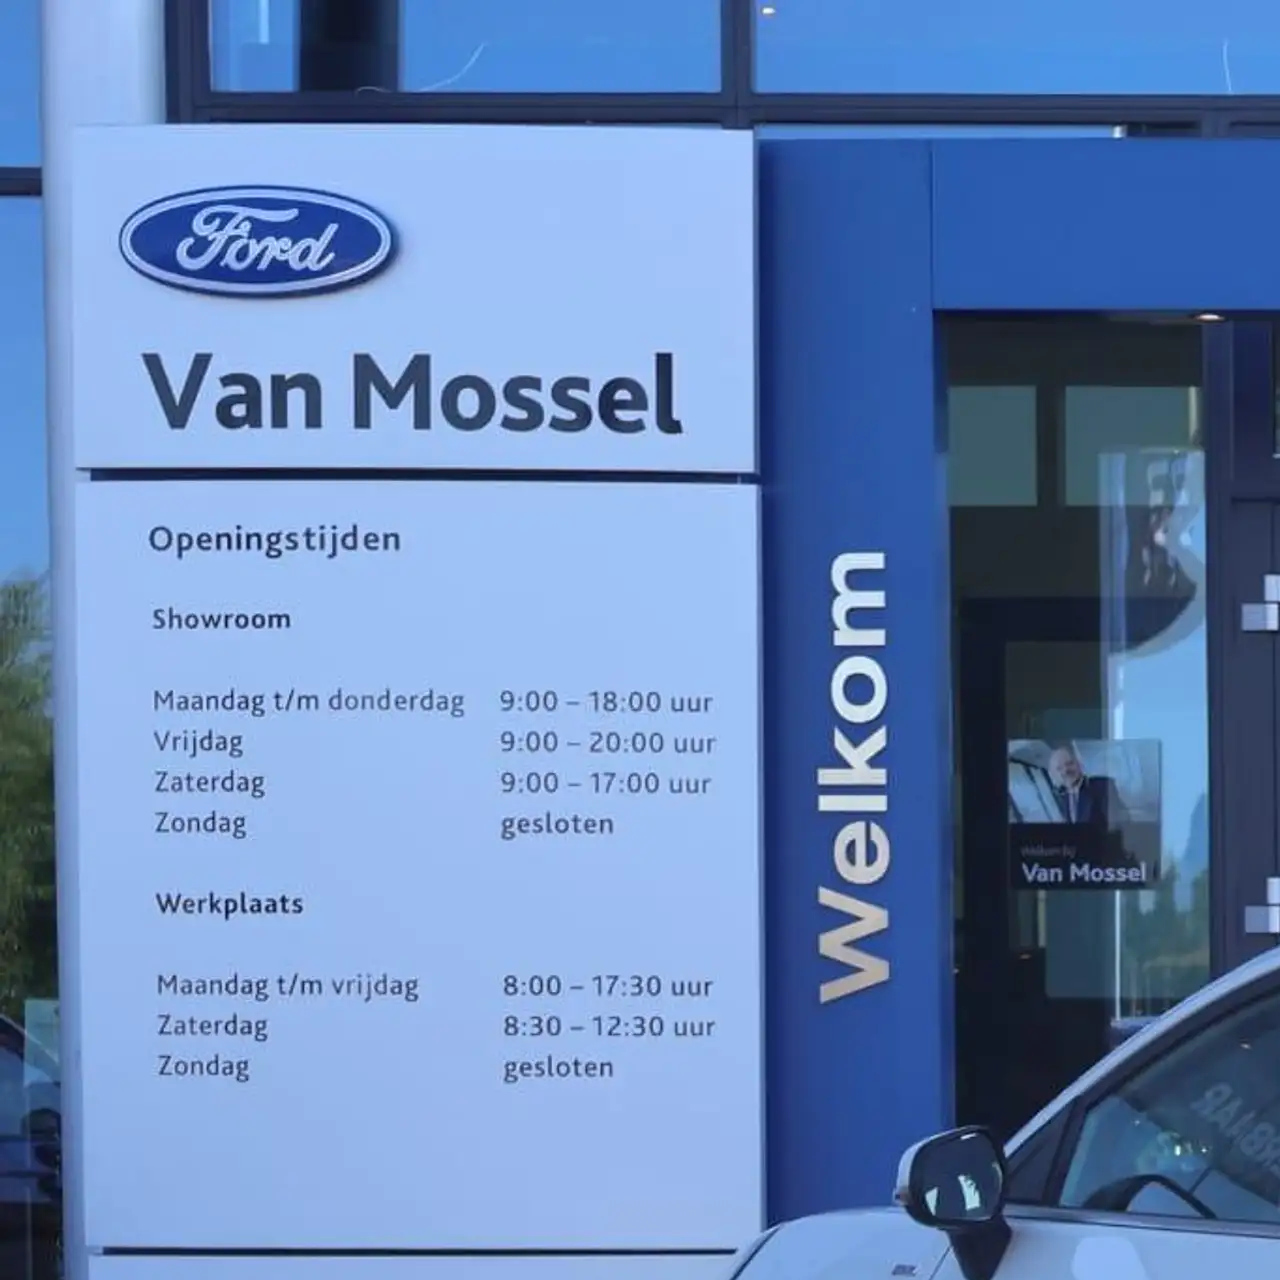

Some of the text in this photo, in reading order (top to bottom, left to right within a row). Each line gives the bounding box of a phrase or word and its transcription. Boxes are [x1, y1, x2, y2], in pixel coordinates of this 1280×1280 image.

[176, 204, 339, 272] Ford
[141, 351, 684, 435] Van Mossel
[148, 523, 400, 560] Openingstijden
[153, 607, 291, 630] Showroom
[153, 687, 266, 718] Maandag
[273, 688, 319, 712] t/m
[328, 687, 465, 718] donderdag
[499, 690, 558, 713] 9:00
[589, 690, 662, 713] 18:00
[670, 697, 713, 713] uur
[153, 729, 244, 759] Vrijdag
[500, 730, 558, 753] 9:00
[589, 731, 664, 754] 20:00
[674, 737, 717, 754] uur
[155, 769, 266, 799] Zaterdag
[500, 771, 559, 794] 9:00
[591, 771, 660, 794] 17:00
[669, 778, 712, 794] uur
[817, 551, 890, 1004] Welkom
[155, 810, 614, 841] Zondag gesloten
[1021, 860, 1147, 882] Van Mossel
[155, 891, 304, 920] Werkplaats
[157, 972, 270, 1002] Maandag
[277, 973, 323, 996] t/m
[331, 973, 419, 1003] vrijdag
[503, 974, 562, 997] 8:00
[592, 974, 662, 997] 17:30
[671, 980, 713, 997] uur
[158, 1012, 268, 1043] Zaterdag
[504, 1015, 562, 1037] 8:30
[592, 1015, 664, 1037] 12:30
[674, 1021, 716, 1037] uur
[158, 1053, 614, 1084] Zondag gesloten
